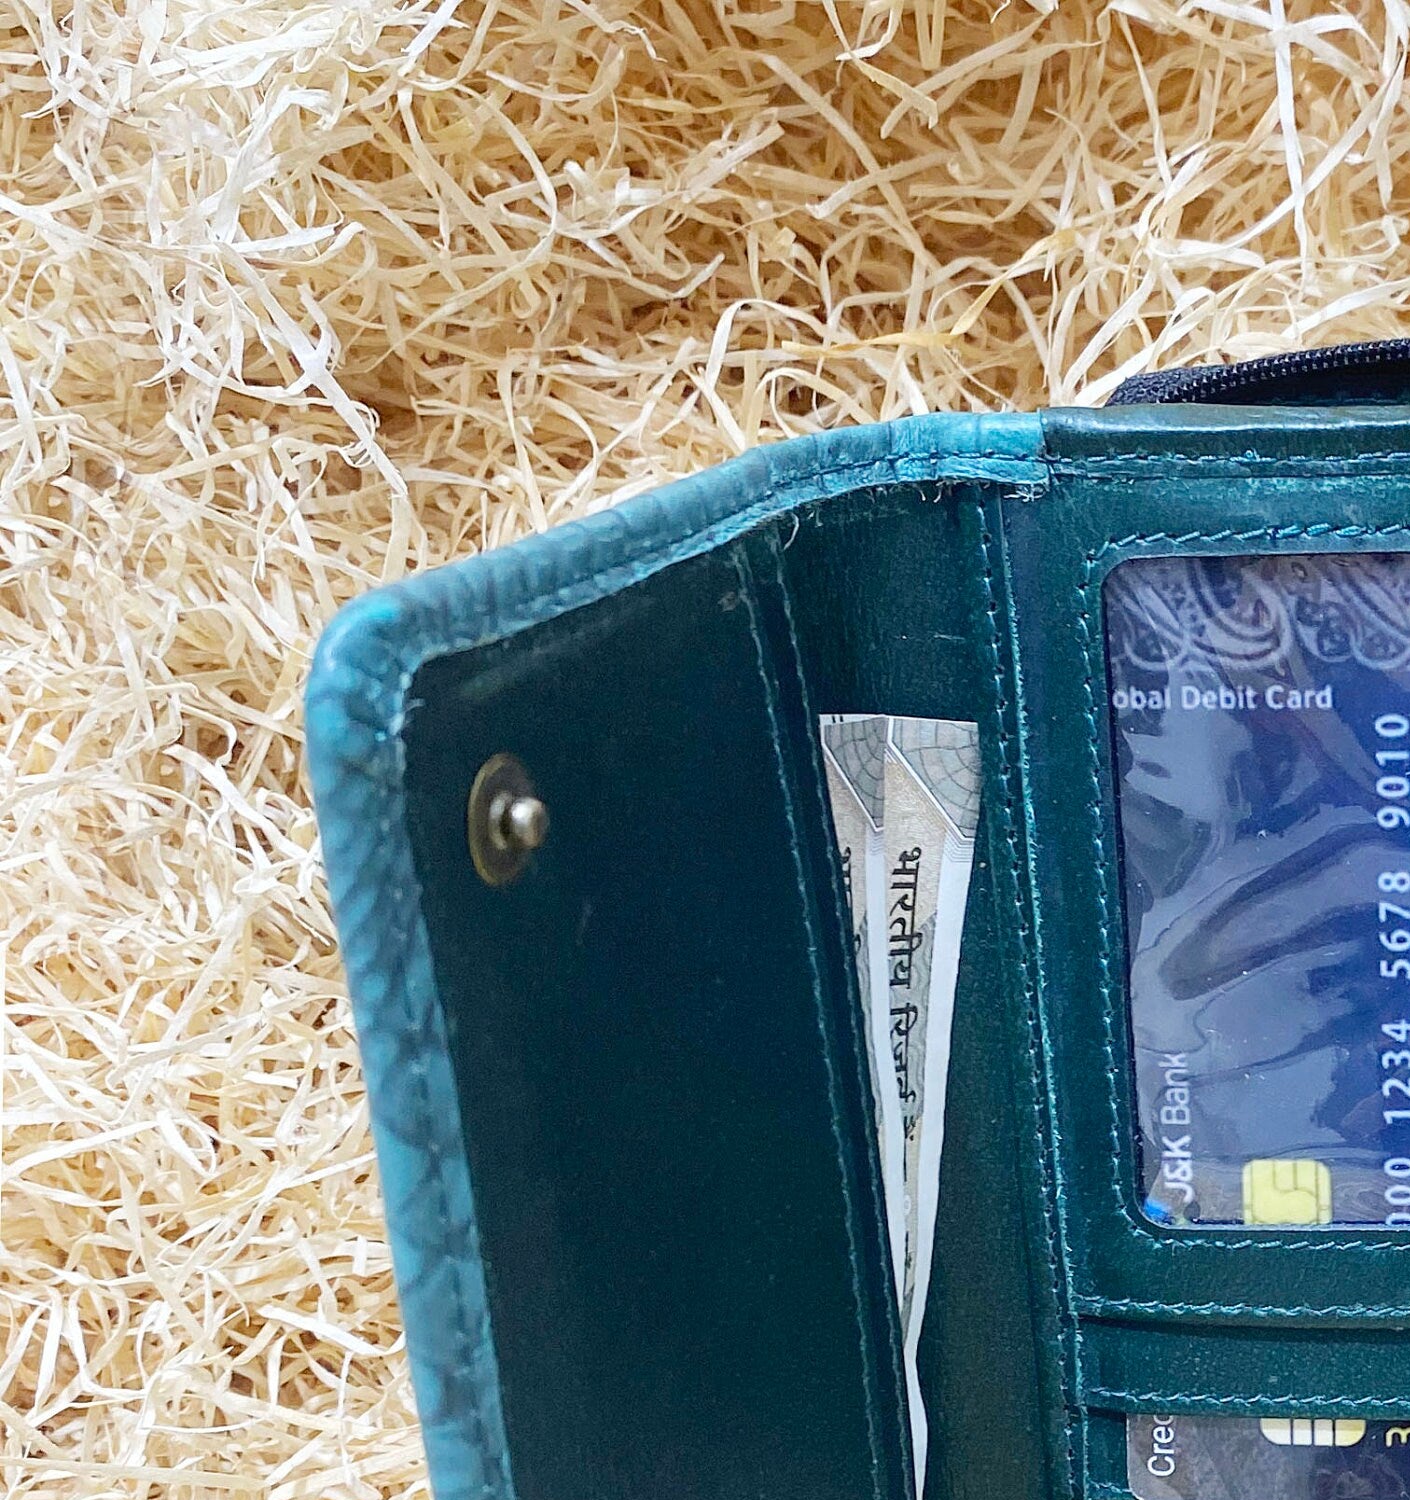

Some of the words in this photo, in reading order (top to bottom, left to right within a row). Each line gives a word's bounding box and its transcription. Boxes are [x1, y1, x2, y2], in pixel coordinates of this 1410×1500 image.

[1181, 685, 1258, 710] Debit
[1264, 684, 1333, 710] Card
[1375, 713, 1410, 829] 9010
[1158, 1052, 1191, 1125] Bank
[1161, 1135, 1195, 1203] J&K
